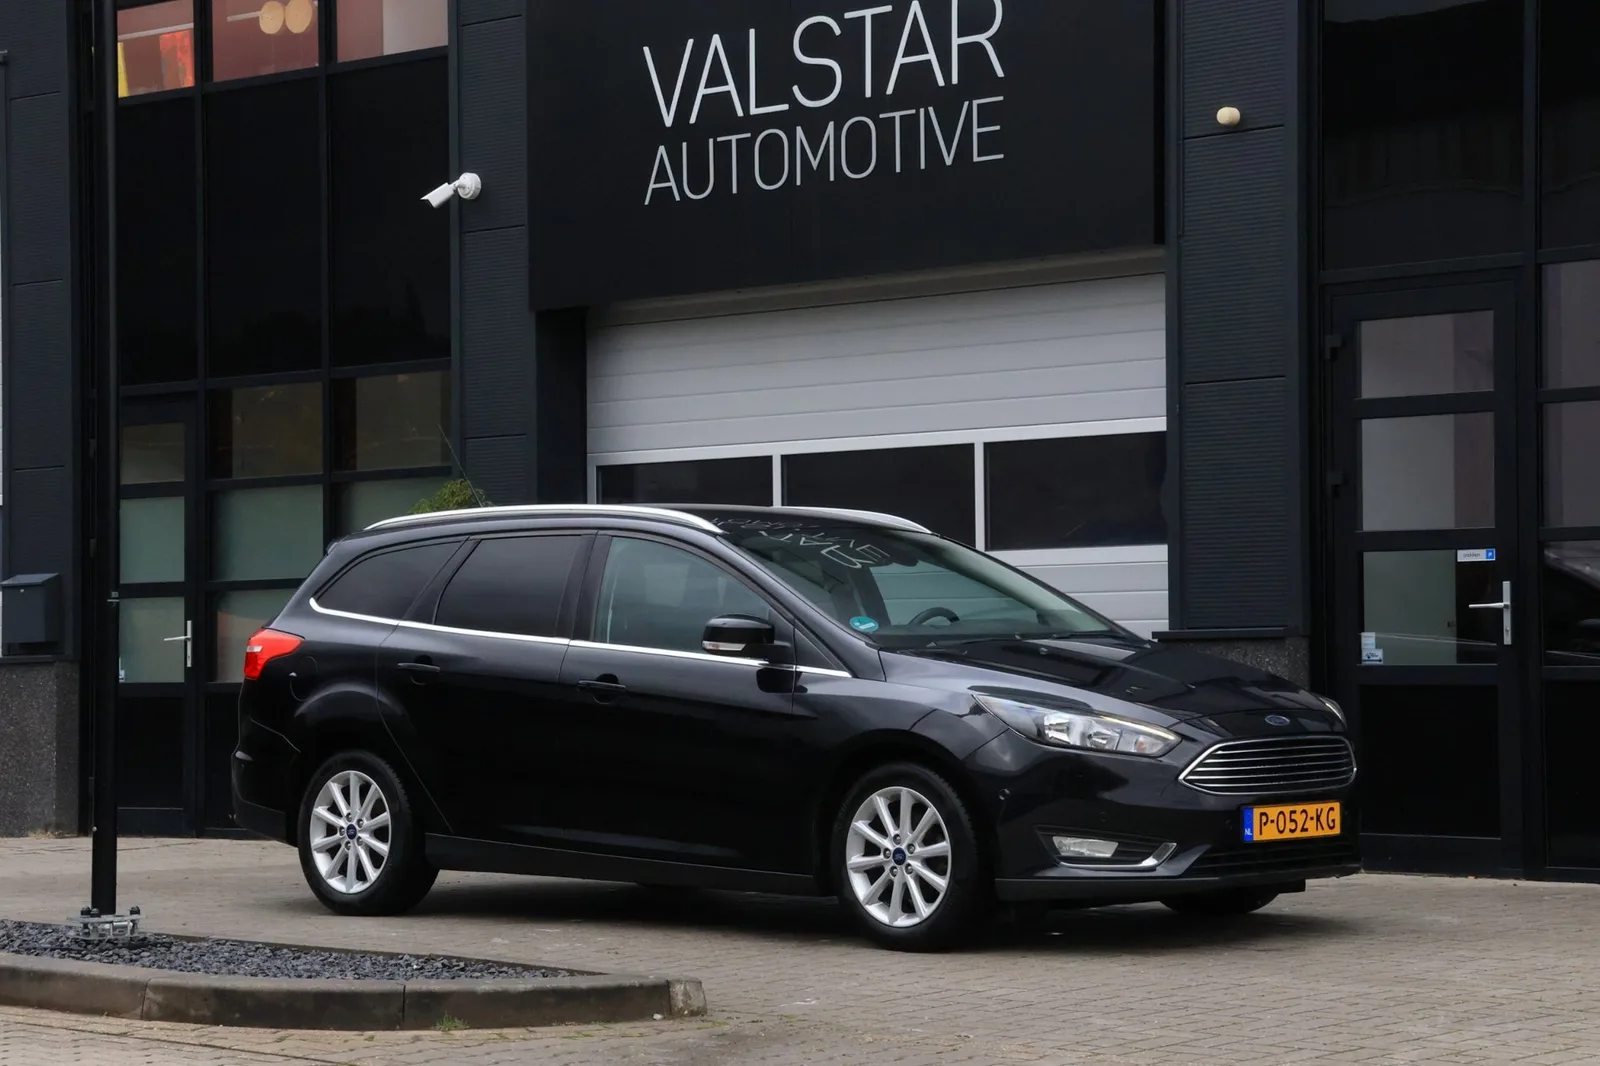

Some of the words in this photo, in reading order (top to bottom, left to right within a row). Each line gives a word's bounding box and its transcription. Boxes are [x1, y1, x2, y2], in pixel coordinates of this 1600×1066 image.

[643, 0, 1005, 127] VALSTAR
[644, 96, 1004, 205] AUTOMOTIVE
[1244, 828, 1252, 836] NL
[1259, 806, 1335, 835] P-052-KG
